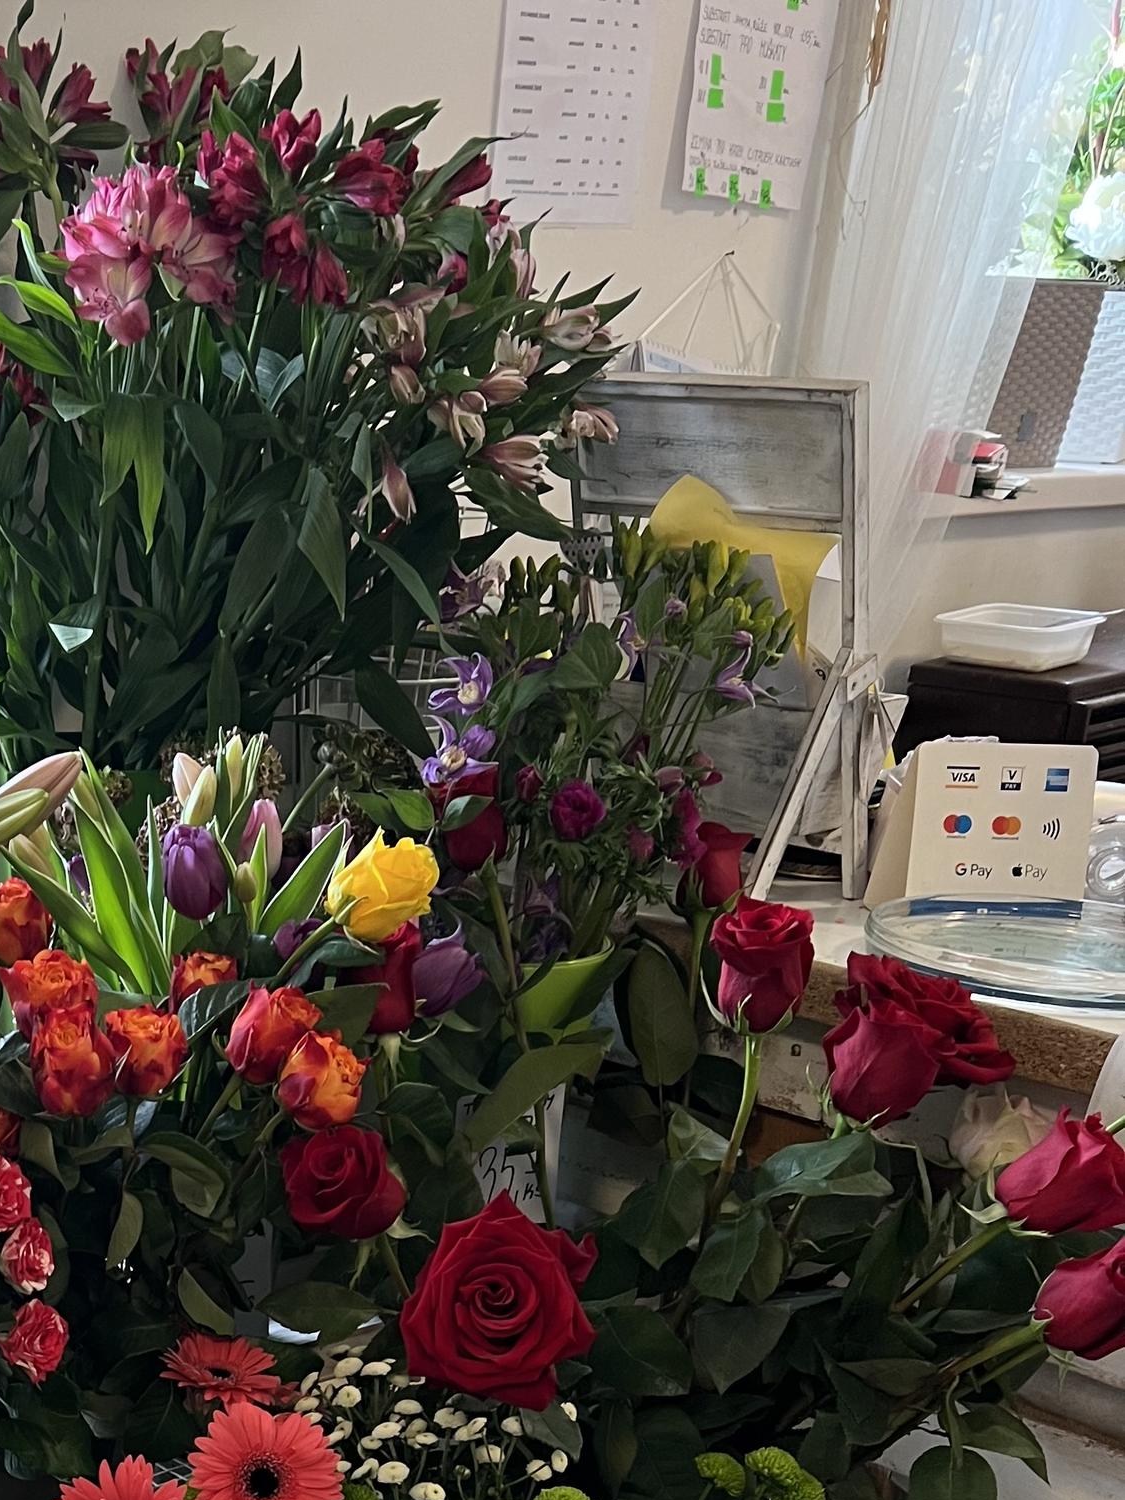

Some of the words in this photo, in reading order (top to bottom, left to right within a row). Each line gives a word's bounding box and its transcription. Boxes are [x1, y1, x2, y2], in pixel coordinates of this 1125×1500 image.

[950, 772, 976, 783] VISA
[1008, 770, 1018, 780] V
[955, 863, 967, 876] G
[970, 863, 993, 879] Pay
[1024, 864, 1048, 881] Pay
